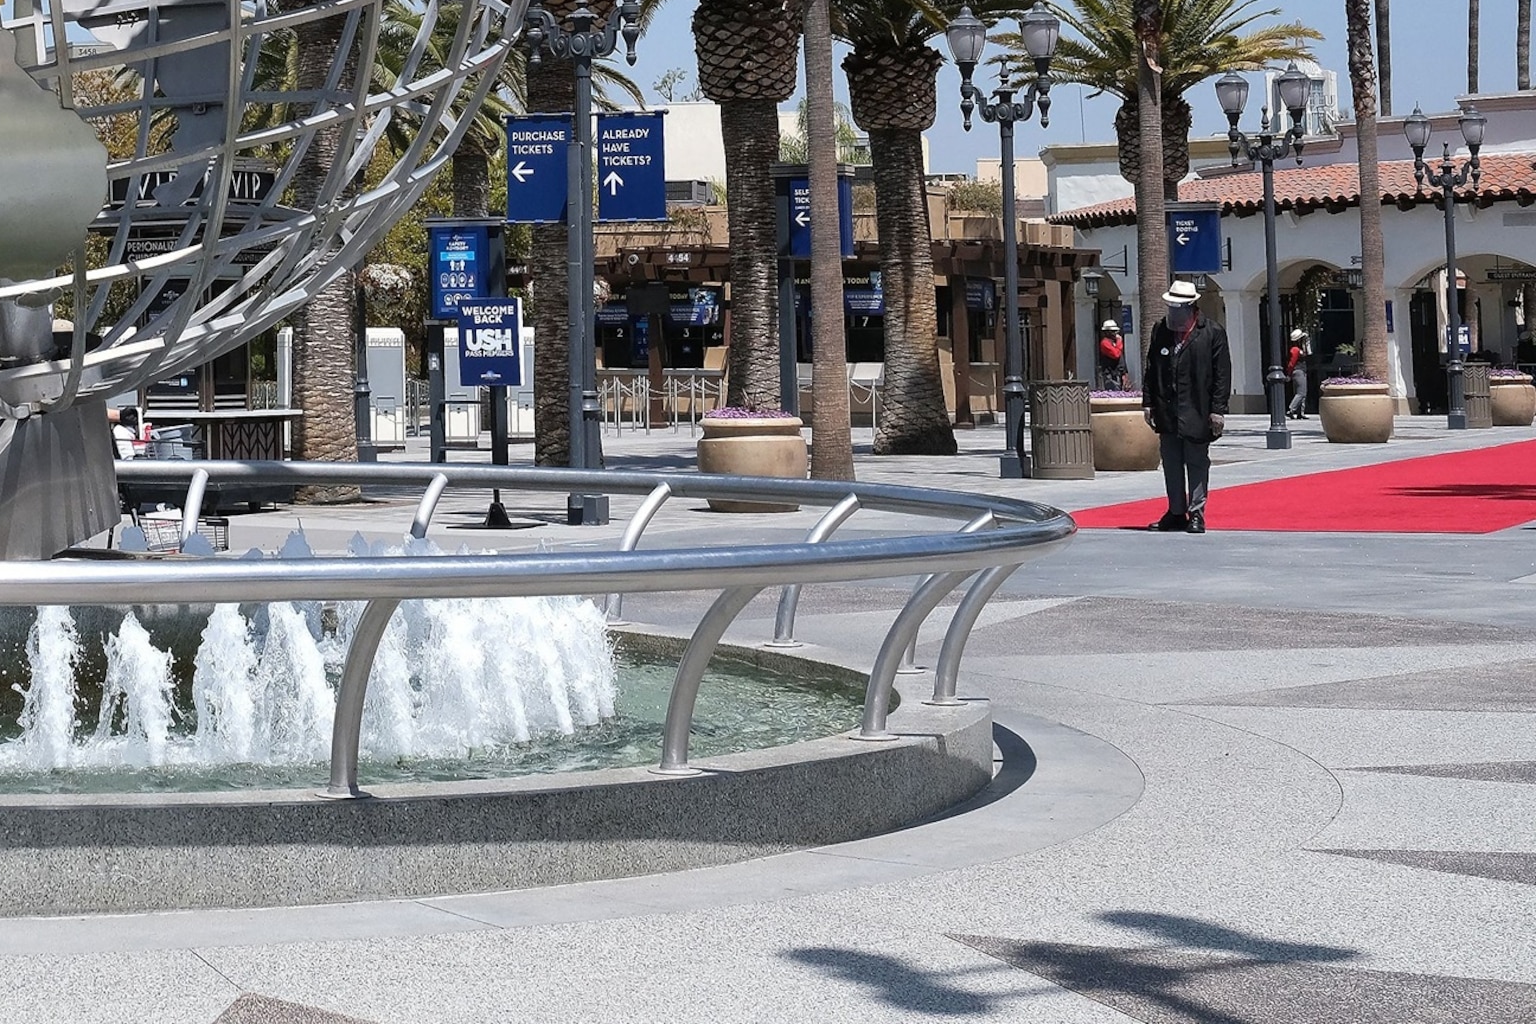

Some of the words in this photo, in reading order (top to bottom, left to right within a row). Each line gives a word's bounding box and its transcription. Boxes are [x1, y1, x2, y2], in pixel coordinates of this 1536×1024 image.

[512, 131, 565, 141] PURCHASE
[602, 128, 650, 140] ALREADY
[512, 144, 553, 154] TICKETS
[602, 142, 630, 153] HAVE
[602, 156, 652, 166] TICKETS?
[231, 172, 261, 199] VIP
[462, 305, 514, 316] WELCOME
[474, 315, 503, 324] BACK
[862, 316, 869, 327] 7
[617, 328, 623, 338] 2
[683, 328, 690, 338] 3
[466, 328, 513, 351] USH
[465, 350, 482, 358] PASS
